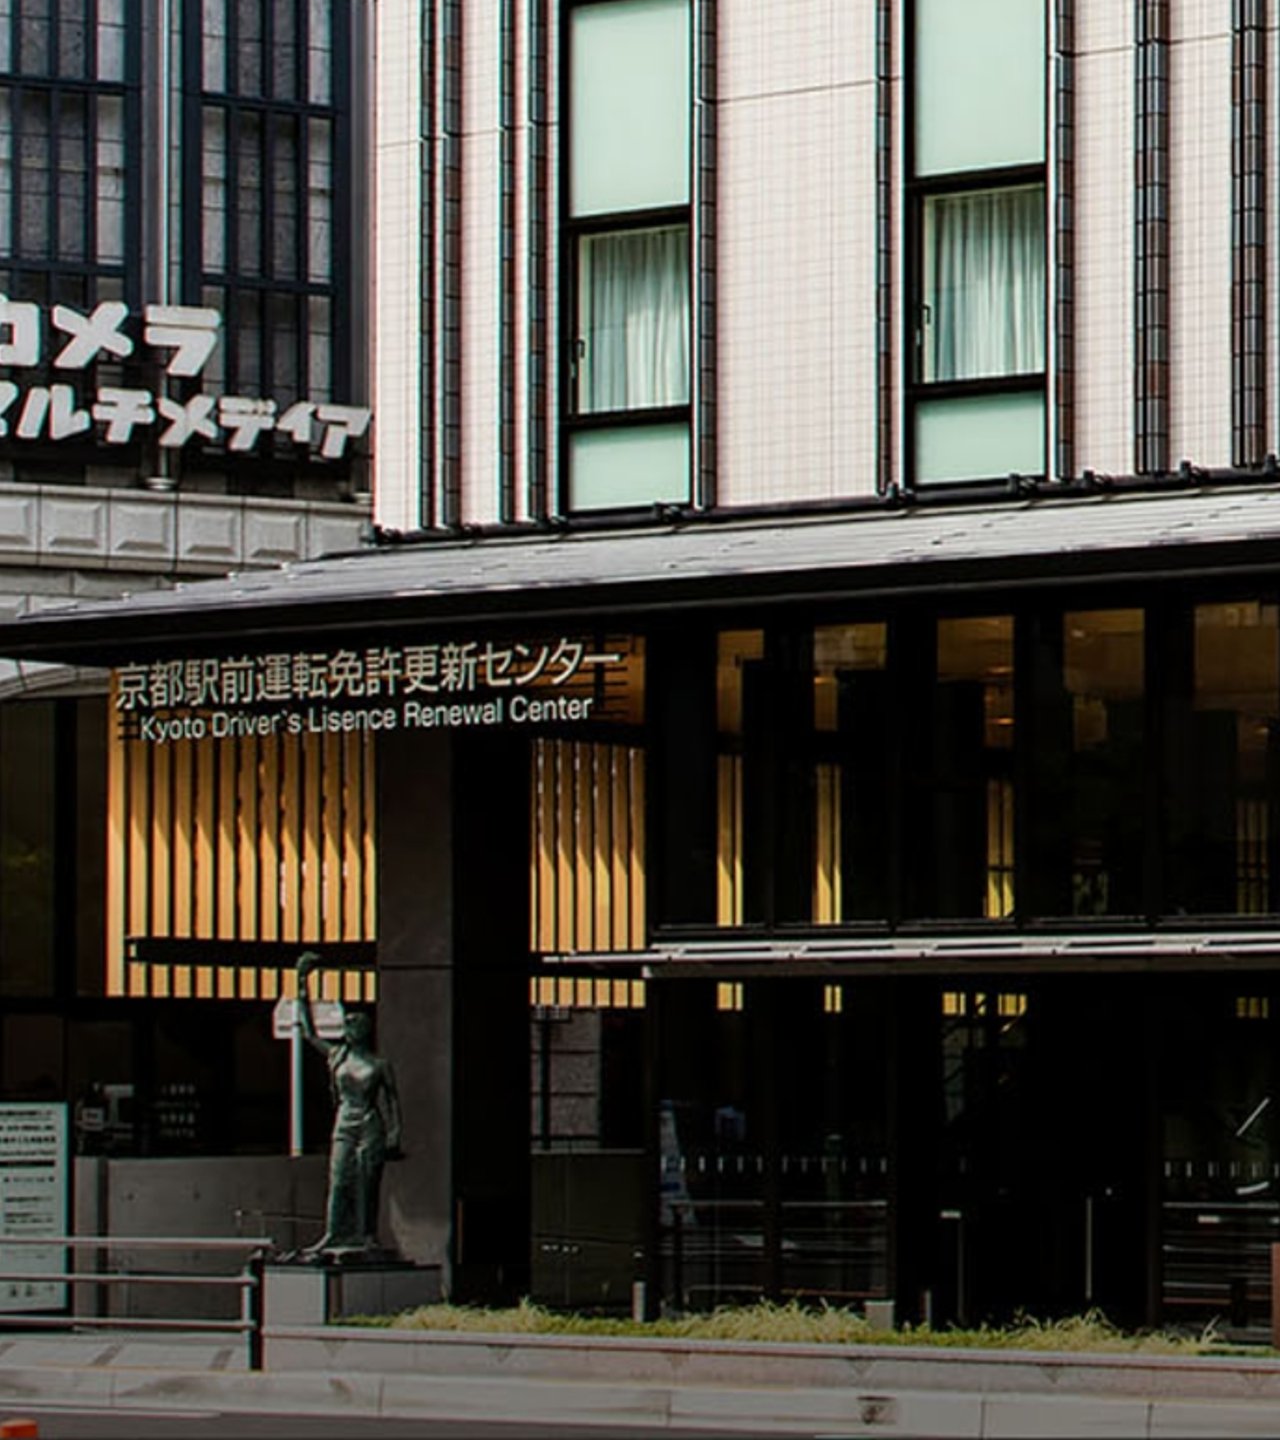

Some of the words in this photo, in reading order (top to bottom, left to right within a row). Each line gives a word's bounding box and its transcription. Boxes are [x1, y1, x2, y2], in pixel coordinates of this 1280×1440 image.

[0, 380, 372, 458] ルチメディア
[115, 637, 620, 710] 京都駅前運転免許更新センター
[140, 715, 206, 744] Kyoto
[308, 705, 396, 733] Lisence
[403, 698, 503, 728] Renewal
[509, 694, 594, 723] Center
